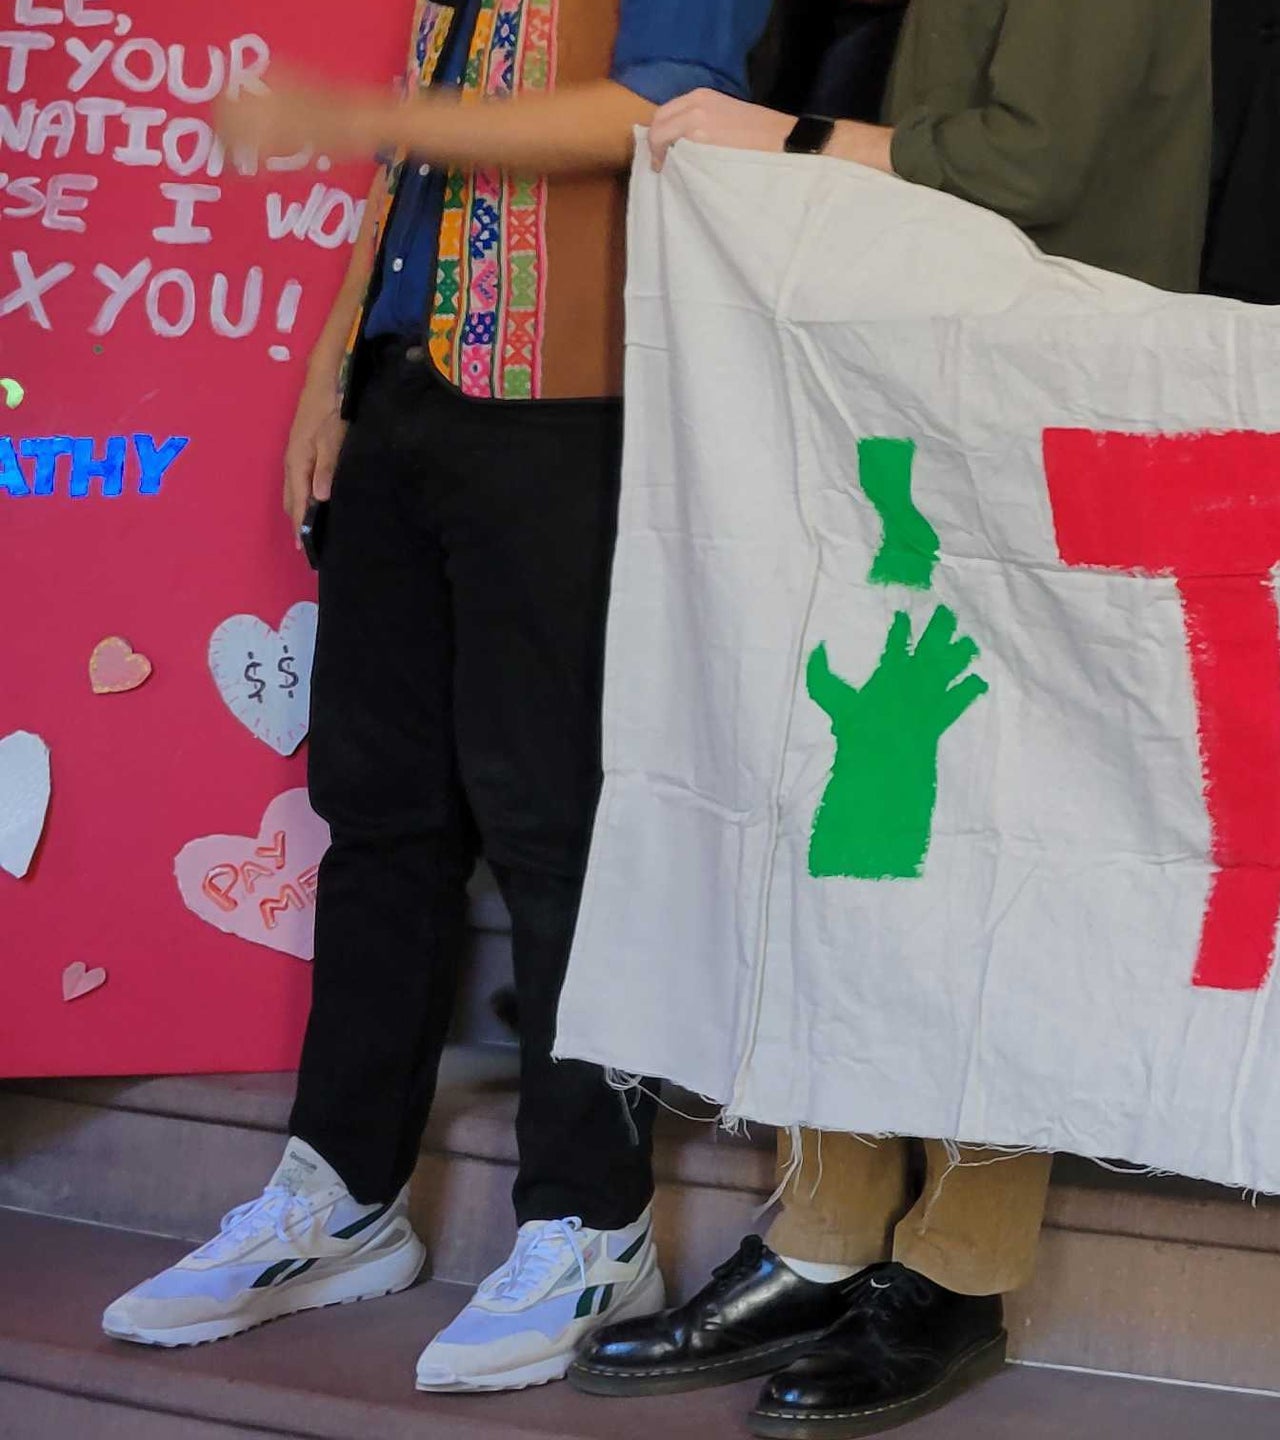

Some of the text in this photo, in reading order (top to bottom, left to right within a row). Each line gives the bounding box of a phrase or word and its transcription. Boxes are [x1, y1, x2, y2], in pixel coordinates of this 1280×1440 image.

[65, 33, 272, 103] YOUR
[0, 172, 98, 234] SE
[152, 182, 221, 244] I
[91, 257, 302, 361] YOU!
[202, 829, 286, 912] PAY
